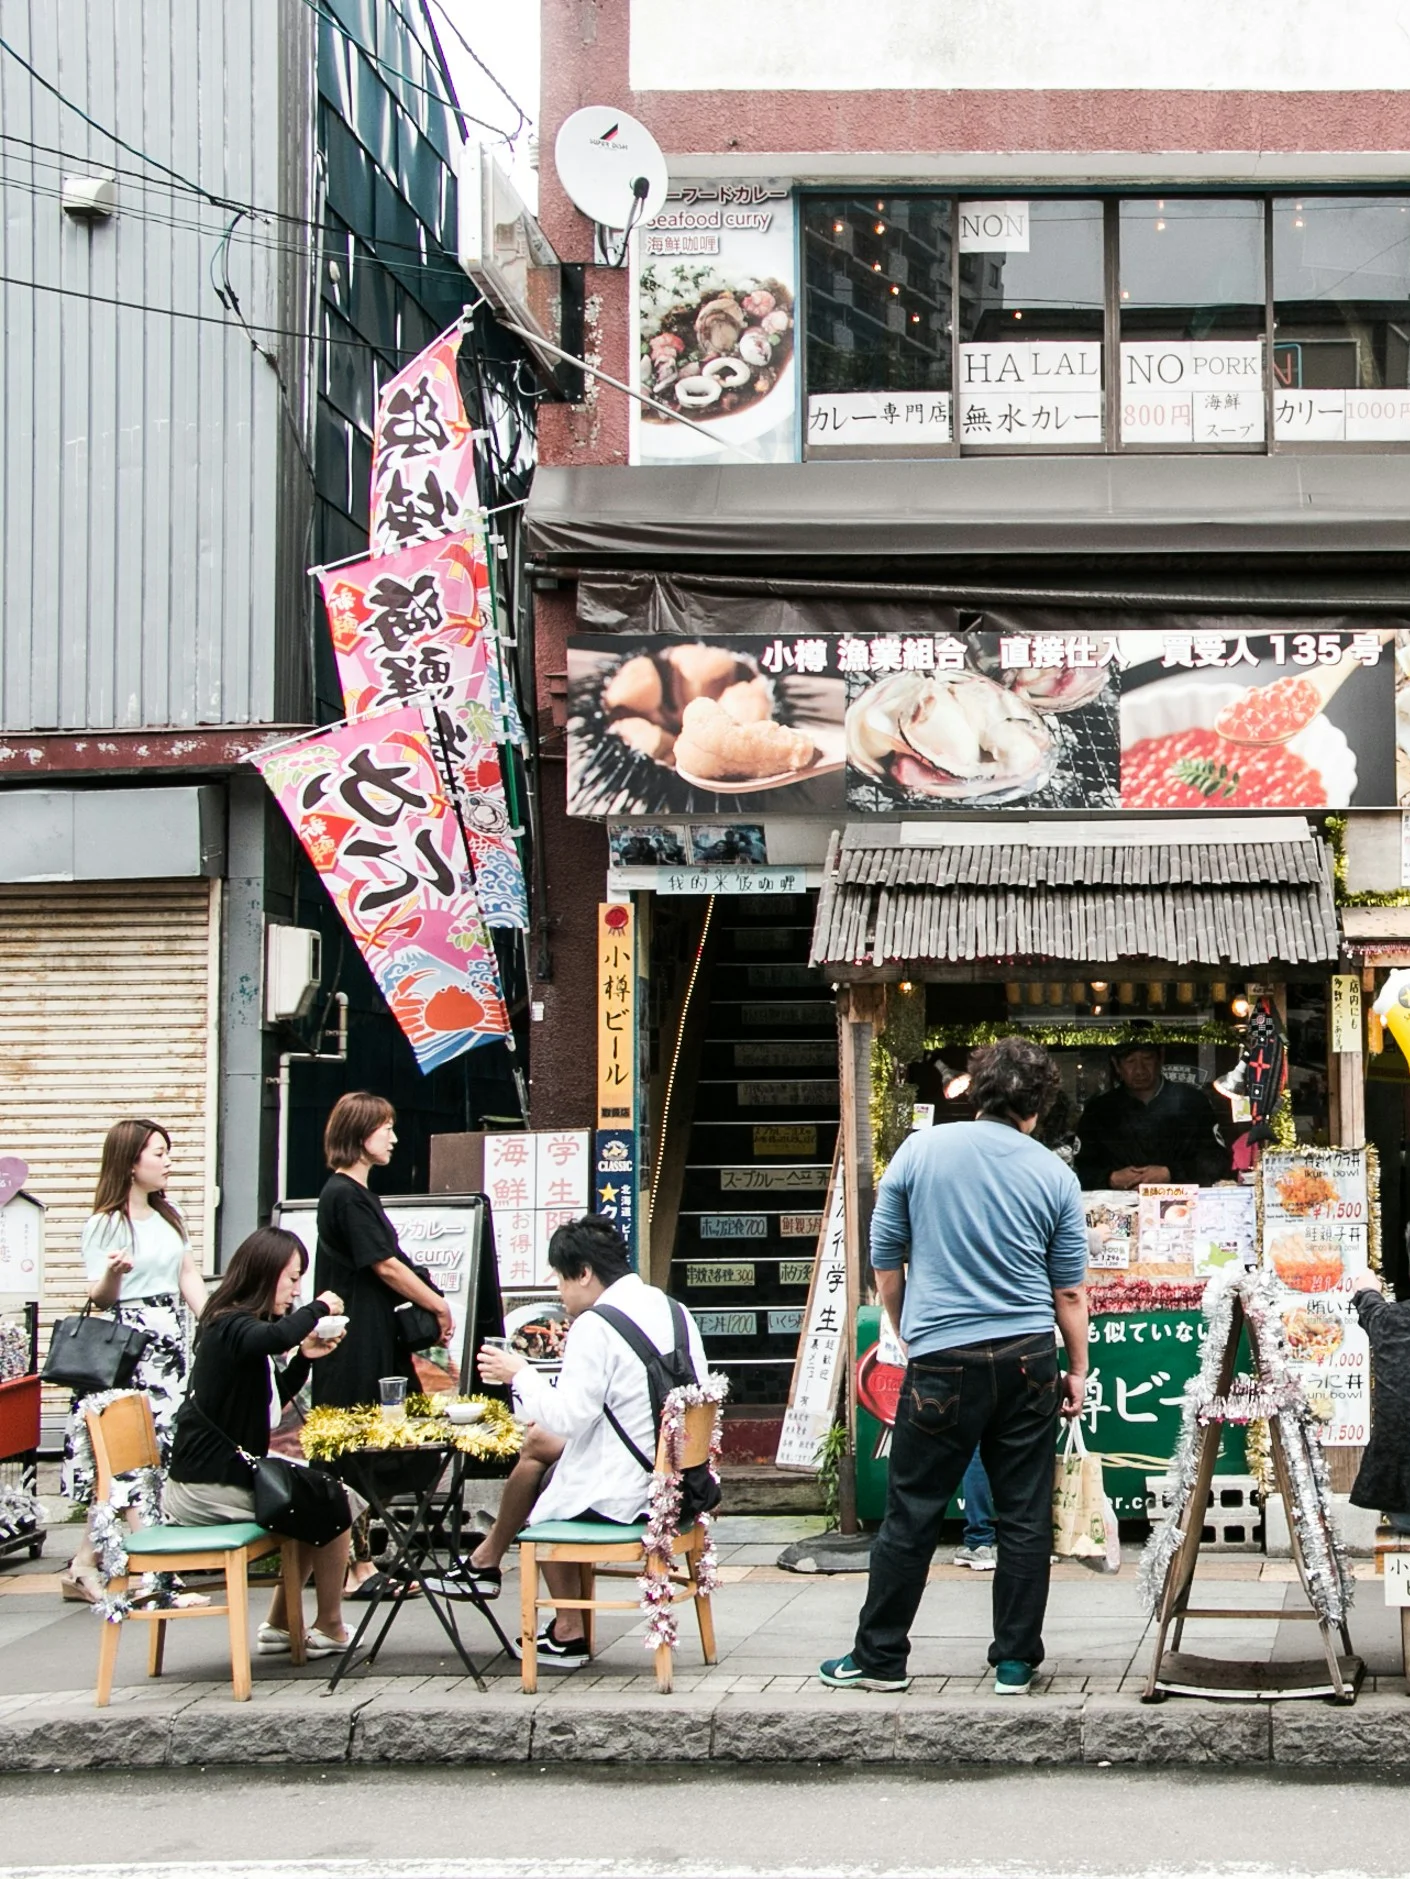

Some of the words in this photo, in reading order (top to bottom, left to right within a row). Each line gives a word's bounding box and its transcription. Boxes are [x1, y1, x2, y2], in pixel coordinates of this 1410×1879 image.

[667, 185, 787, 204] ーフードカレー
[725, 212, 772, 232] curry
[959, 210, 1026, 240] NON
[1125, 352, 1186, 387] NO
[1191, 354, 1259, 378] PORK
[1204, 393, 1243, 412] 海鮮
[1273, 399, 1346, 426] カリー
[806, 402, 951, 434] カレー専門店
[961, 399, 1102, 439] 無水カレー
[1123, 402, 1193, 430] 800円
[1204, 420, 1257, 442] スープ
[761, 638, 829, 675] 小樽
[836, 635, 970, 674] 漁業組合
[1000, 632, 1131, 671] 直接仕入
[1161, 634, 1262, 669] 買受人
[602, 943, 632, 1087] 小樽ビール
[597, 1159, 634, 1173] CLASSIC
[620, 1183, 632, 1243] 北海道、ビー
[1312, 1202, 1362, 1221] ¥1,500
[413, 1247, 463, 1268] curry
[697, 1312, 754, 1333] モン丼1200
[1316, 1352, 1363, 1368] ¥1,000
[1306, 1372, 1364, 1390] うに丼
[1330, 1389, 1363, 1400] bowl
[1314, 1423, 1365, 1442] ¥1,500
